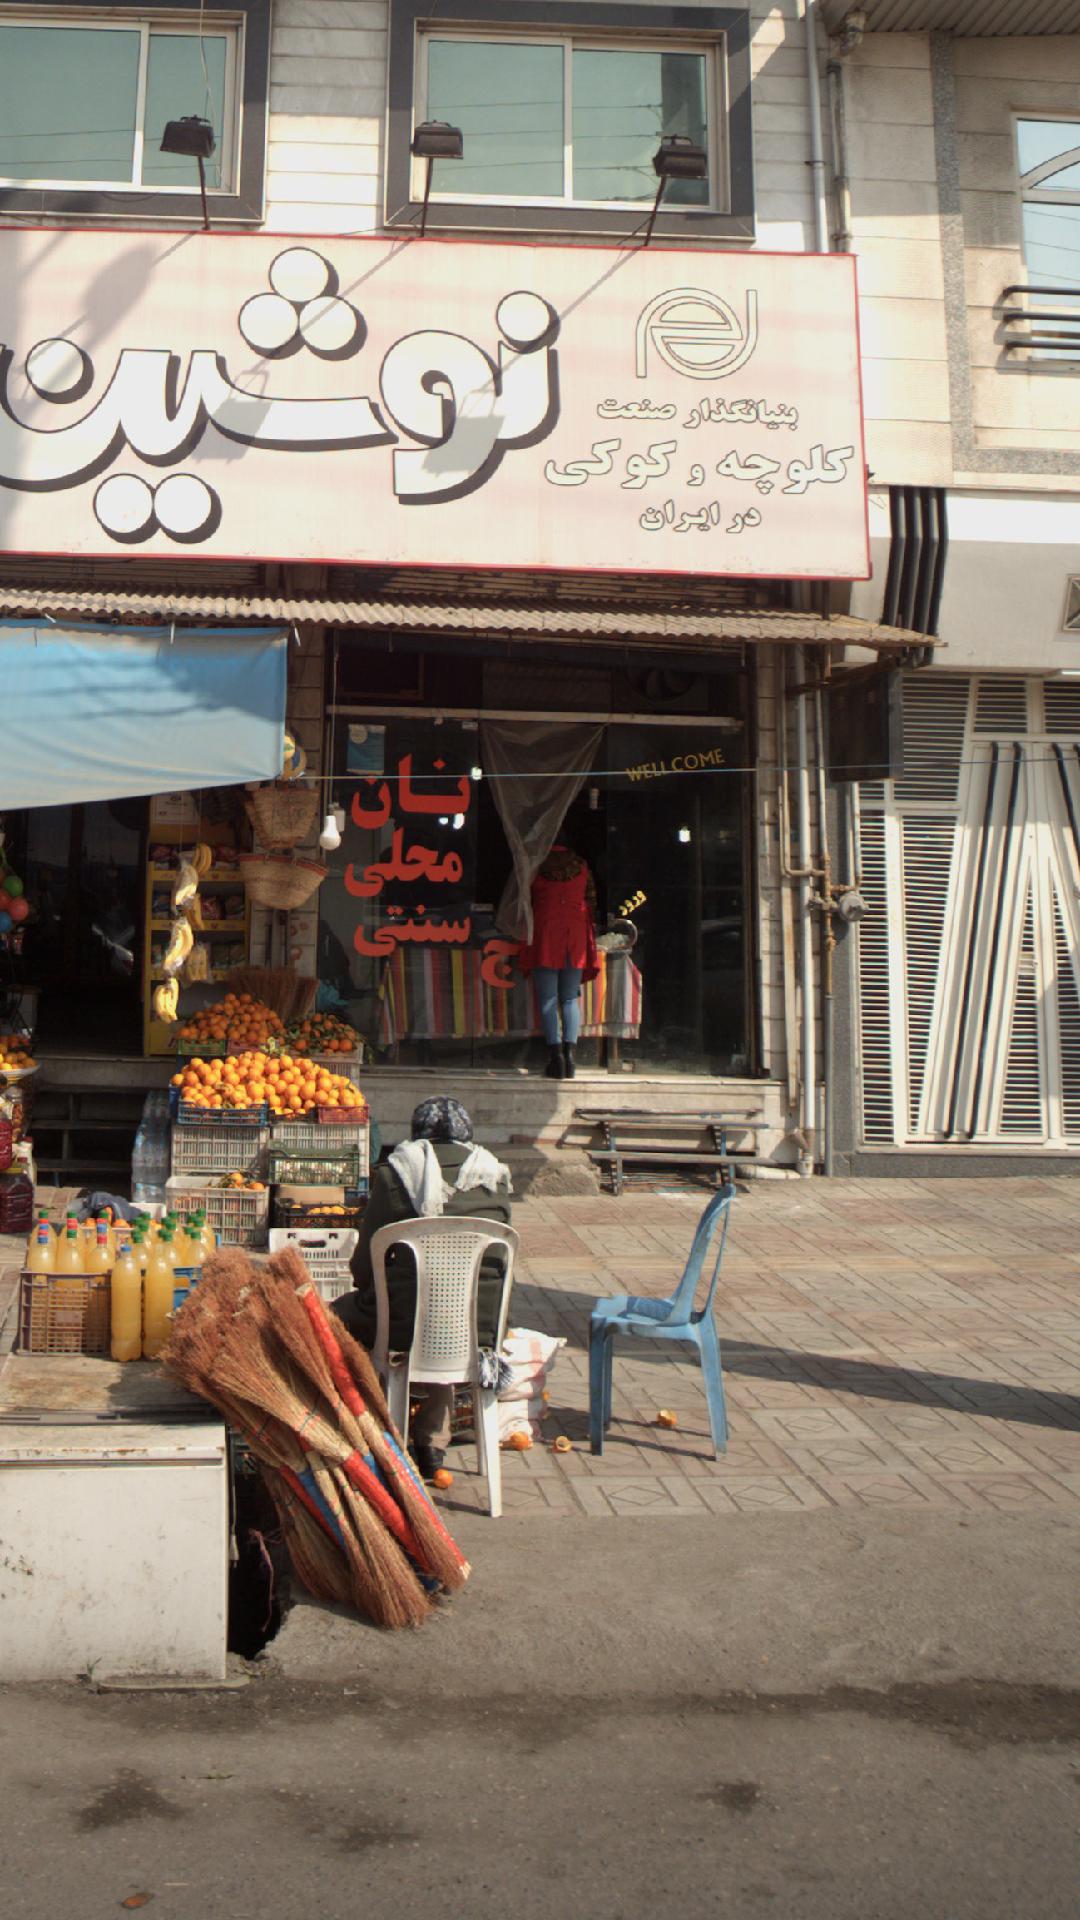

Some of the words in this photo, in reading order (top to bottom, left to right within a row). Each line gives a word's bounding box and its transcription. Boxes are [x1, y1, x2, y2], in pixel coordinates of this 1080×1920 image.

[0, 247, 560, 544] نوشین
[597, 399, 676, 419] صنعت
[683, 398, 798, 430] بنیانگذار
[544, 438, 677, 489] کوکی
[687, 464, 705, 486] و
[716, 444, 854, 494] کلوچه
[639, 499, 720, 532] ایران
[726, 507, 761, 533] در
[626, 748, 725, 782] WELLCOME
[351, 753, 471, 829] نان
[344, 827, 463, 897] محلی
[353, 904, 471, 957] سنتی
